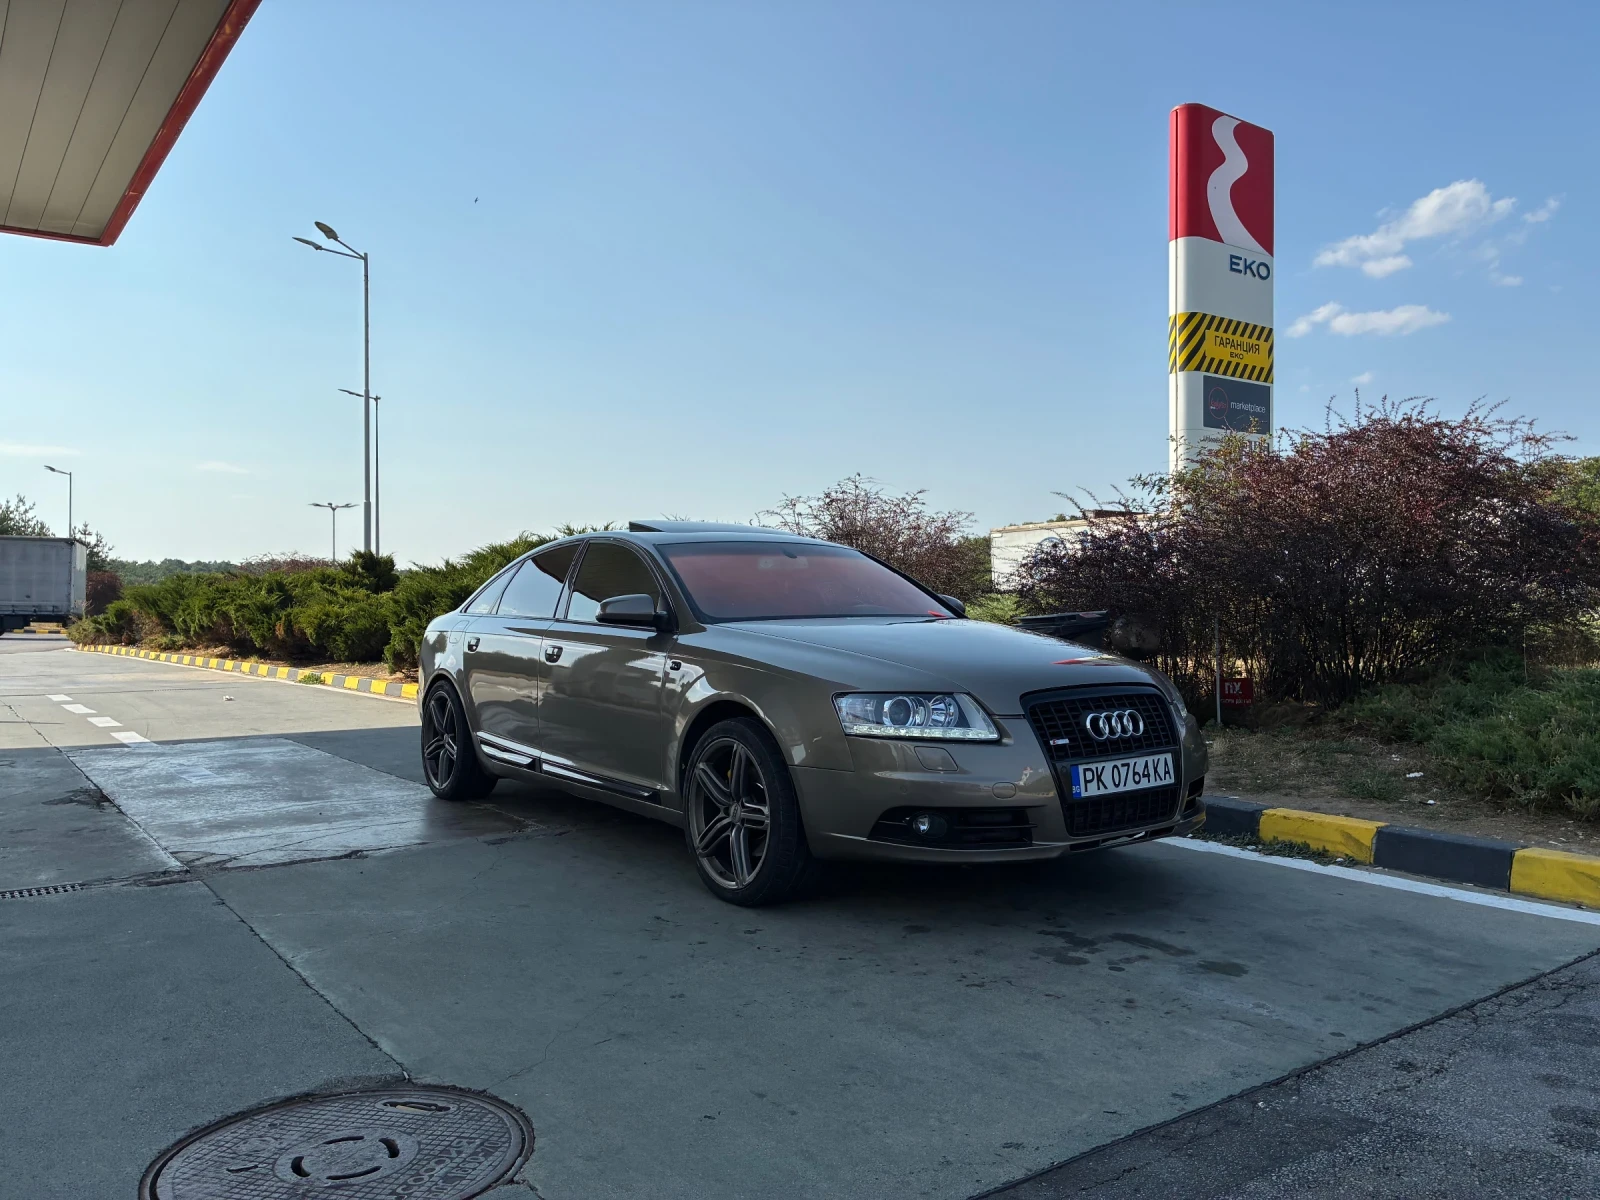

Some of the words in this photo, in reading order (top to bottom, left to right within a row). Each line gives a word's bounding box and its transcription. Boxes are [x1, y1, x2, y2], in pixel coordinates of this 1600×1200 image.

[1229, 254, 1271, 281] EKO
[1214, 336, 1260, 355] ГАРАНЦИЯ
[1230, 352, 1244, 360] EKO
[1230, 401, 1266, 414] marketplace
